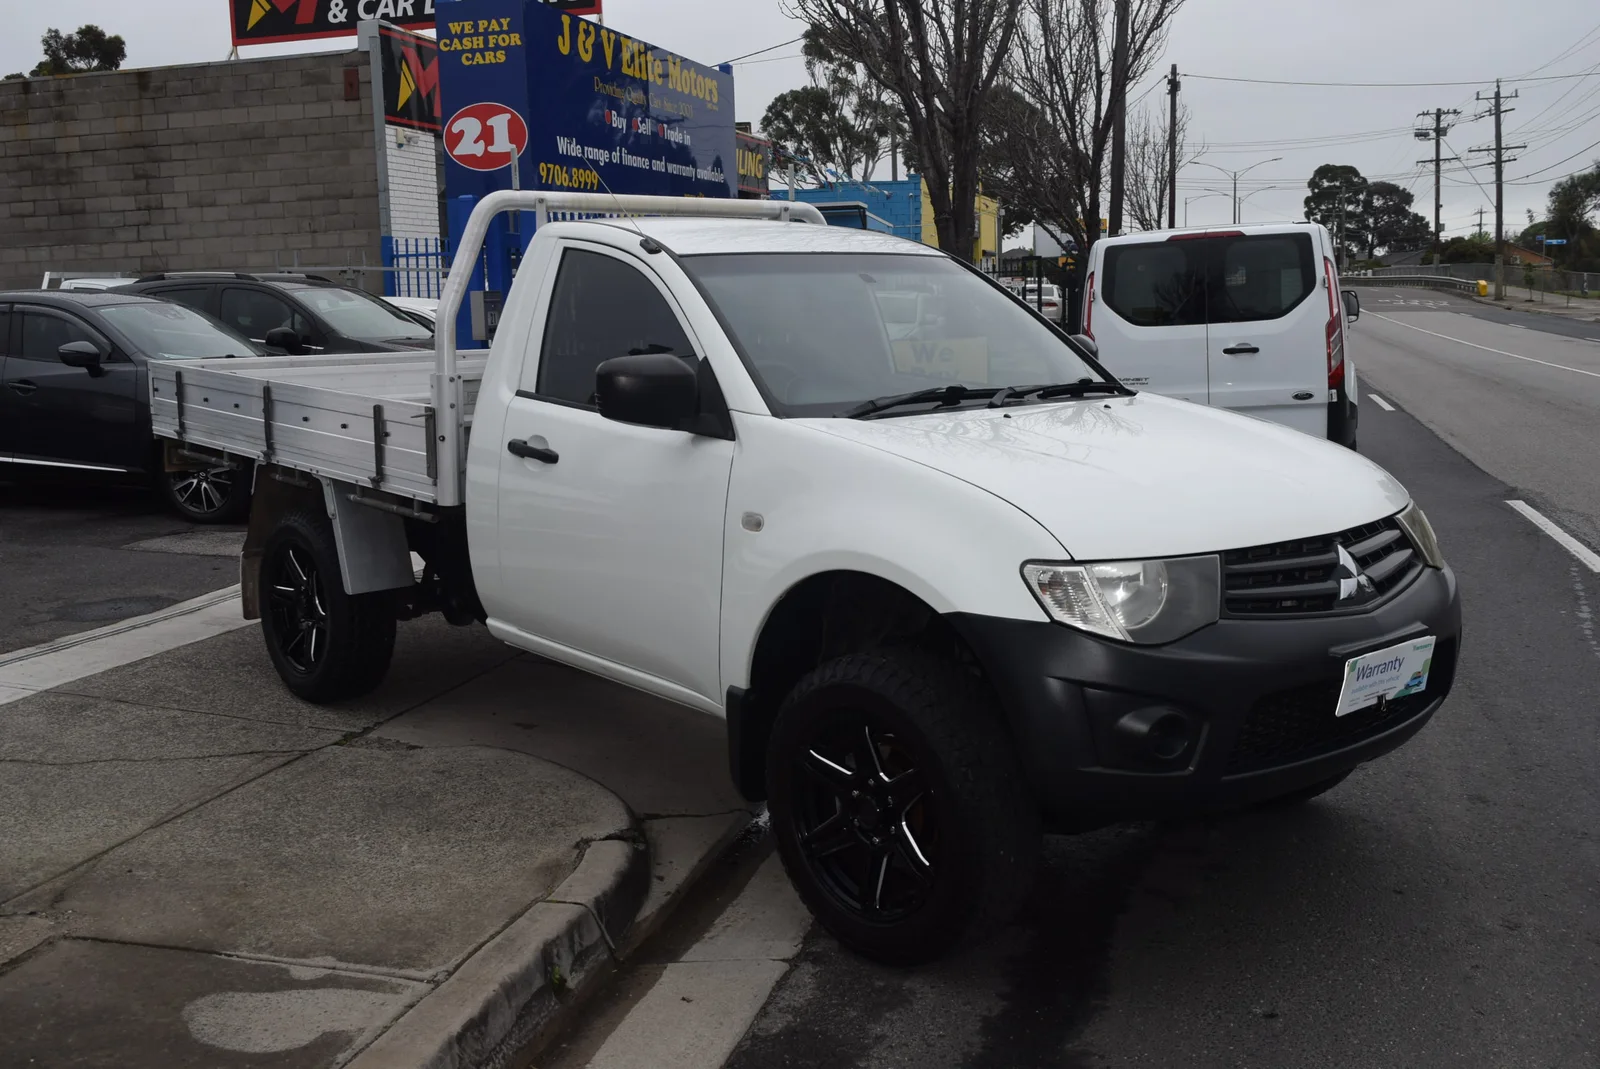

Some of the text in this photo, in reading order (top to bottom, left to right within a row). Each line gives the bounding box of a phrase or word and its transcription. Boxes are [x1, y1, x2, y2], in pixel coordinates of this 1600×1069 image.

[327, 0, 348, 24] &
[357, 0, 414, 20] CAR
[448, 18, 511, 34] WE PAY
[439, 33, 522, 51] CASH FOR
[461, 50, 506, 66] CARS
[557, 14, 719, 104] J & V Elite Motors
[451, 113, 517, 157] 21
[611, 110, 691, 145] Buy Sell Trade in
[556, 135, 725, 183] Wide range of finance and warranty available
[539, 162, 599, 191] 9706.8999
[911, 342, 955, 363] We
[1356, 656, 1405, 682] Warranty
